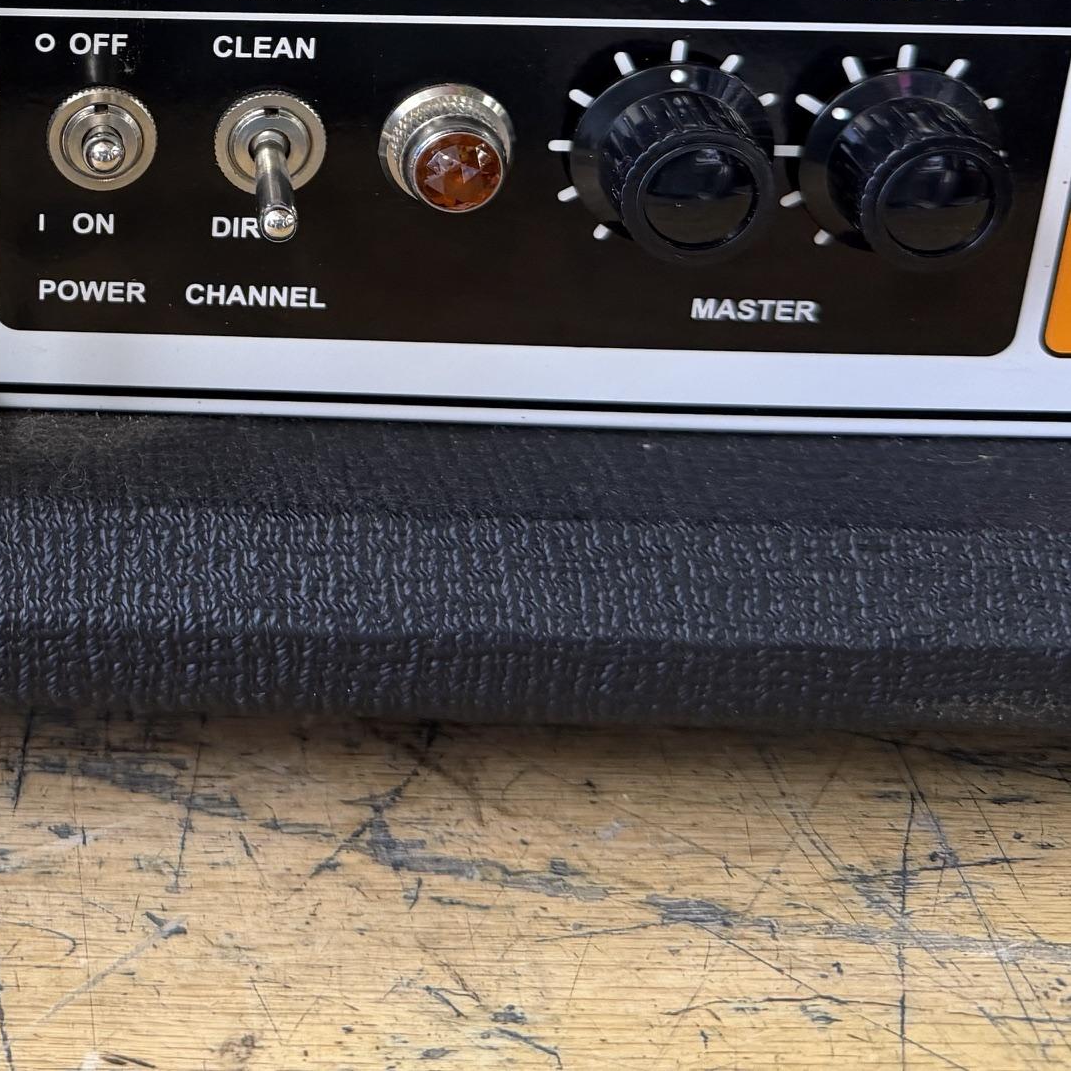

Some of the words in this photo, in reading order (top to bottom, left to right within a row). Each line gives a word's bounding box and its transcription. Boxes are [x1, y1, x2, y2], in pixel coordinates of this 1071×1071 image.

[69, 32, 129, 56] OFF
[212, 35, 316, 60] CLEAN
[72, 212, 115, 235] ON
[211, 216, 261, 239] DIR
[38, 279, 146, 303] POWER
[185, 283, 326, 308] CHANNEL
[690, 297, 817, 322] MASTER
